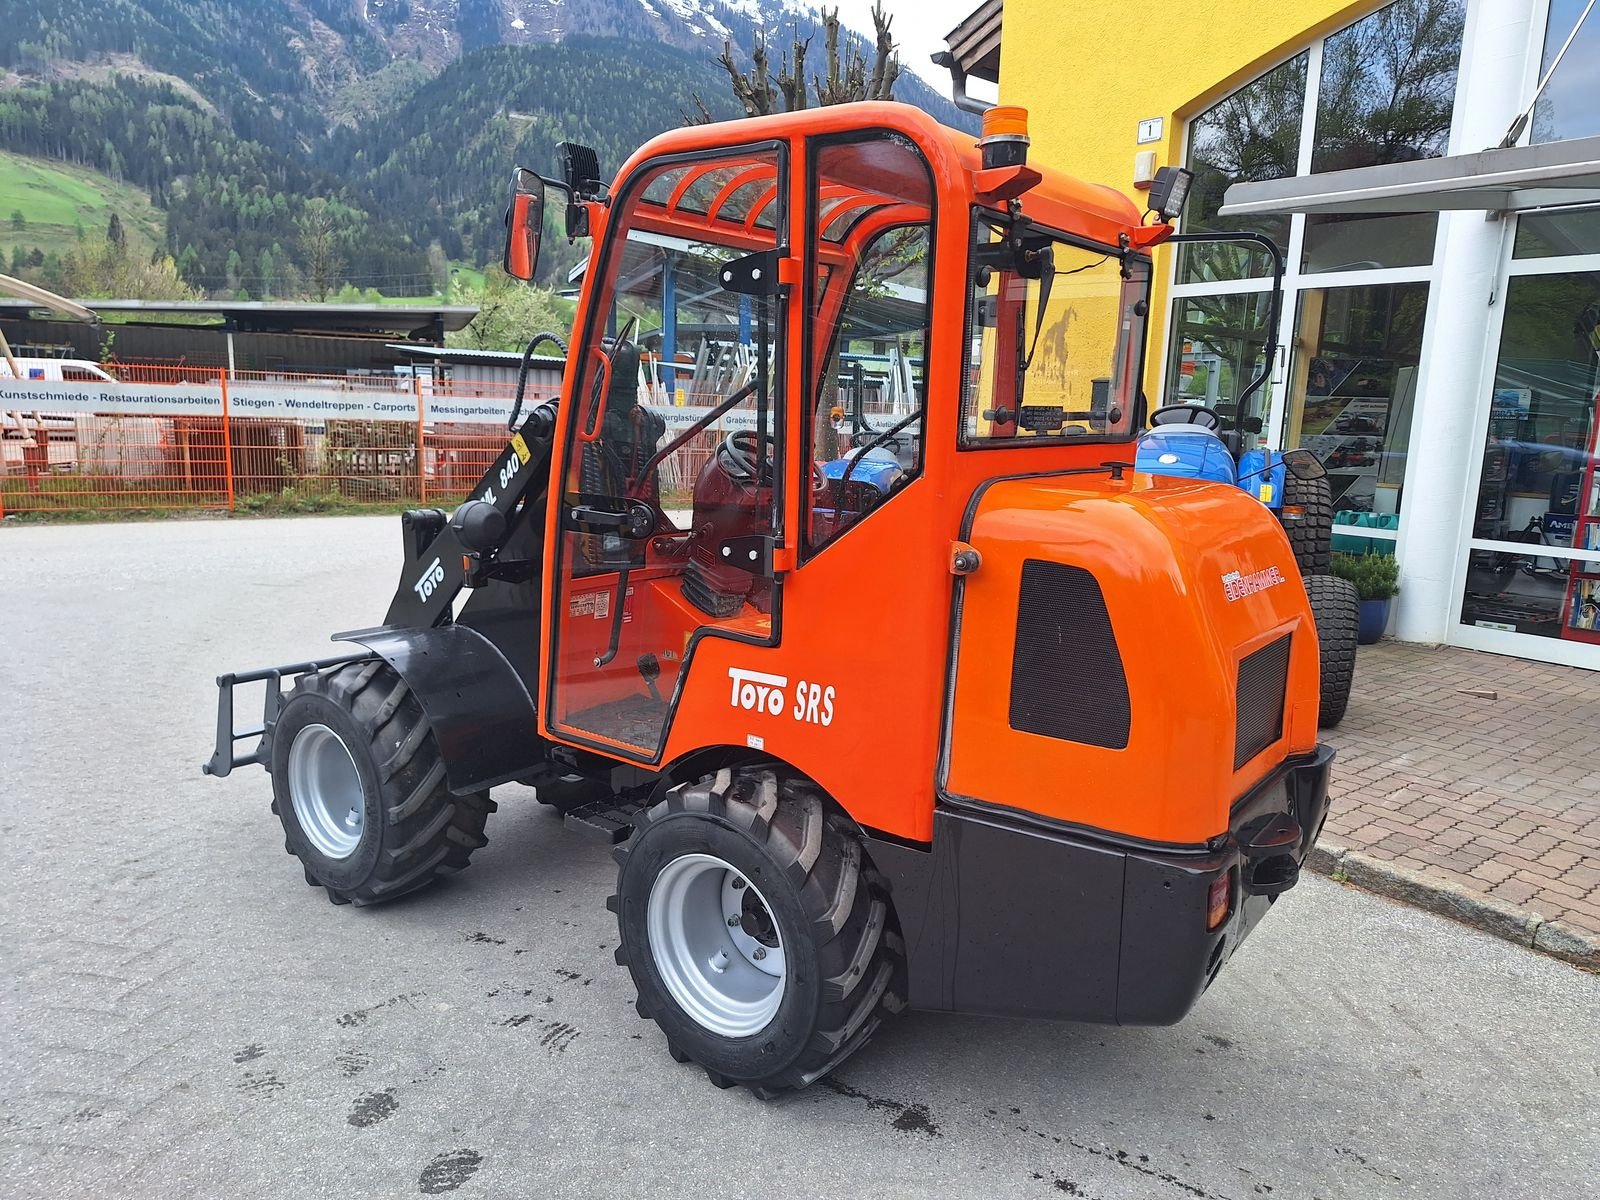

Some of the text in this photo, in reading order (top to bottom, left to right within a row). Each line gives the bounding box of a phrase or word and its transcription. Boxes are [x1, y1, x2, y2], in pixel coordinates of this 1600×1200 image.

[1148, 124, 1152, 136] 1
[0, 389, 89, 403] Kunstschmiede
[100, 392, 221, 406] Restaurationsarbeiten
[233, 396, 275, 409] Stiegen
[285, 398, 365, 412] Wendeltreppen
[373, 401, 416, 413] Carports
[430, 404, 506, 418] Messingarbeiten
[726, 416, 756, 424] Grabkreu
[500, 452, 520, 489] 840
[728, 667, 836, 726] TOYO SRS
